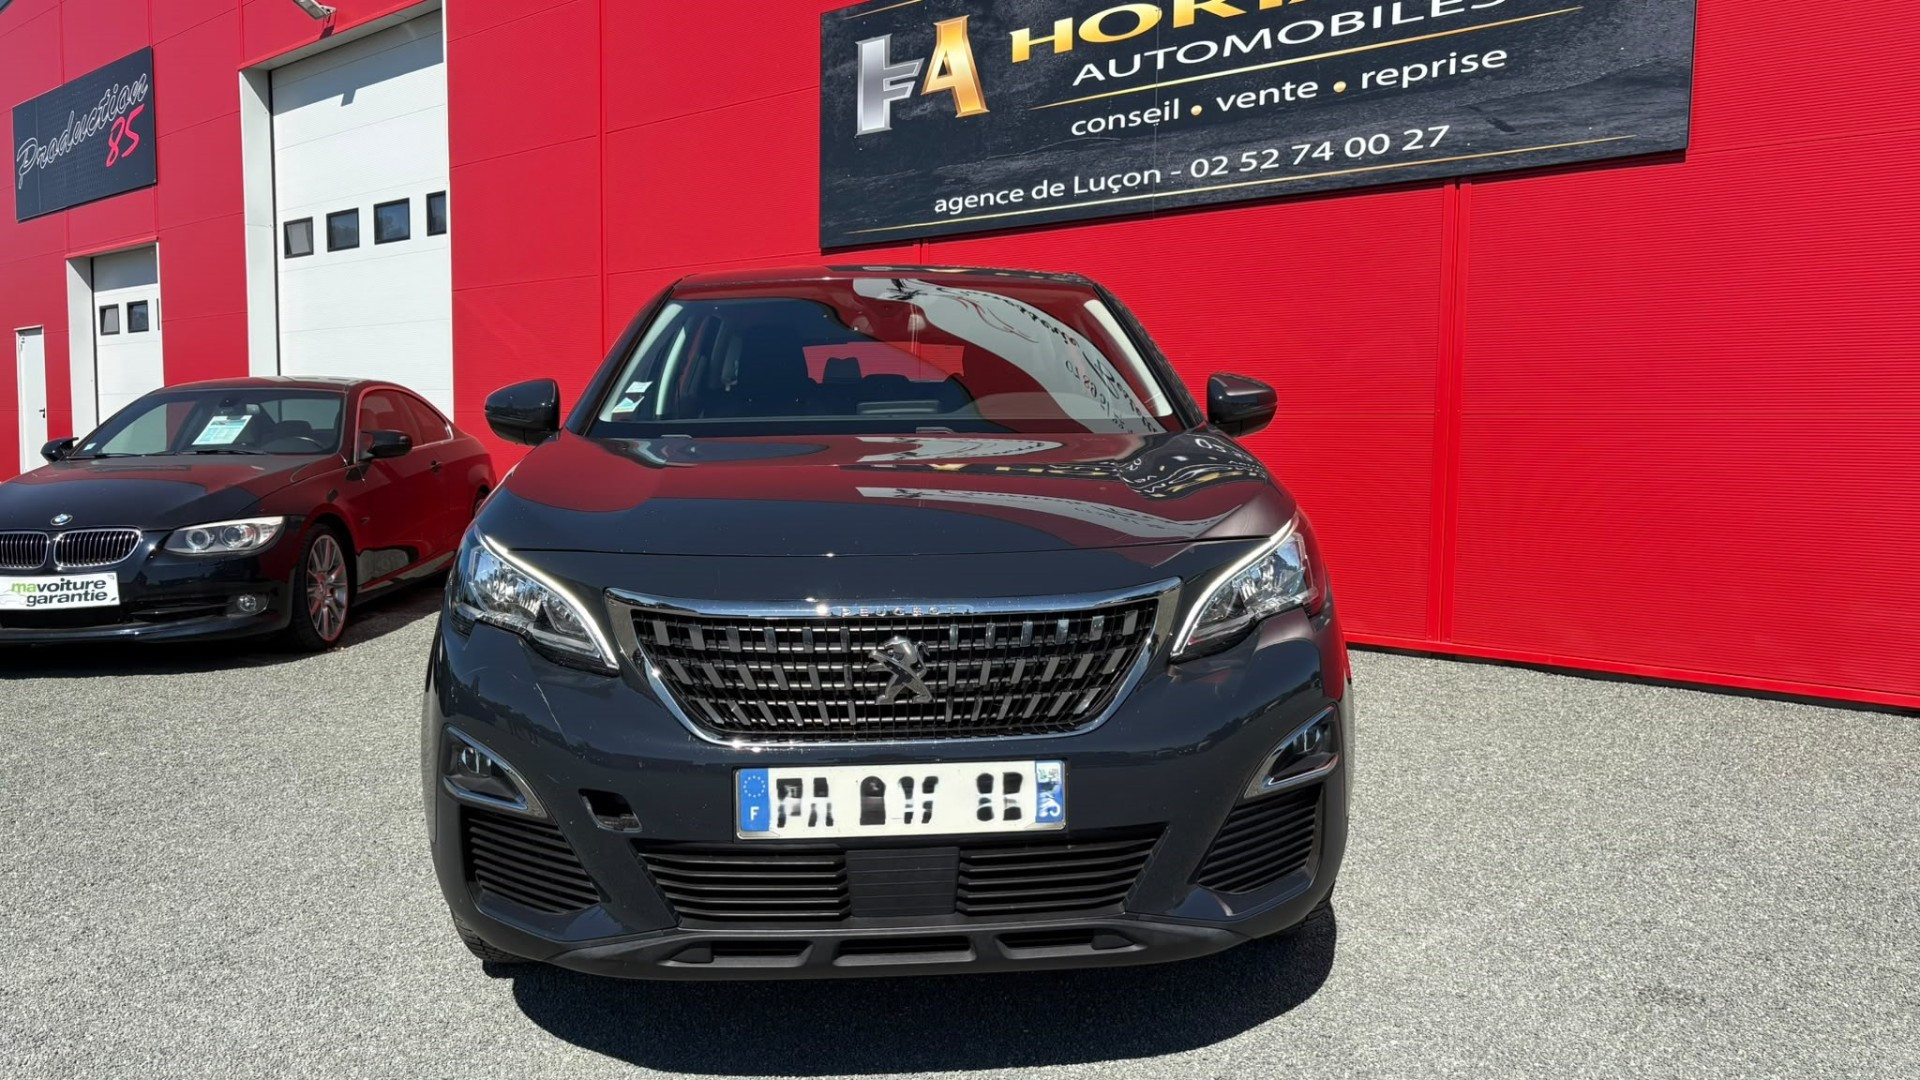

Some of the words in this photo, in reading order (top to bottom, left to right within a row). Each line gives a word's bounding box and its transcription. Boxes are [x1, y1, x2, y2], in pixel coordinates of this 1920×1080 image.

[1071, 98, 1180, 136] conseil
[1216, 80, 1319, 112] vente
[1361, 47, 1508, 89] reprise
[16, 73, 149, 190] Production
[106, 104, 145, 167] 85
[934, 187, 1024, 215] agence
[1032, 179, 1065, 201] de
[1073, 166, 1161, 194] Luçon
[1190, 157, 1229, 178] 02
[1240, 149, 1280, 173] 52
[1292, 141, 1334, 165] 74
[1344, 134, 1391, 159] 00
[1402, 125, 1450, 150] 27
[11, 577, 107, 593] mavoiture
[26, 589, 108, 607] garantie
[841, 605, 957, 618] PEUGEOT
[749, 806, 760, 821] F
